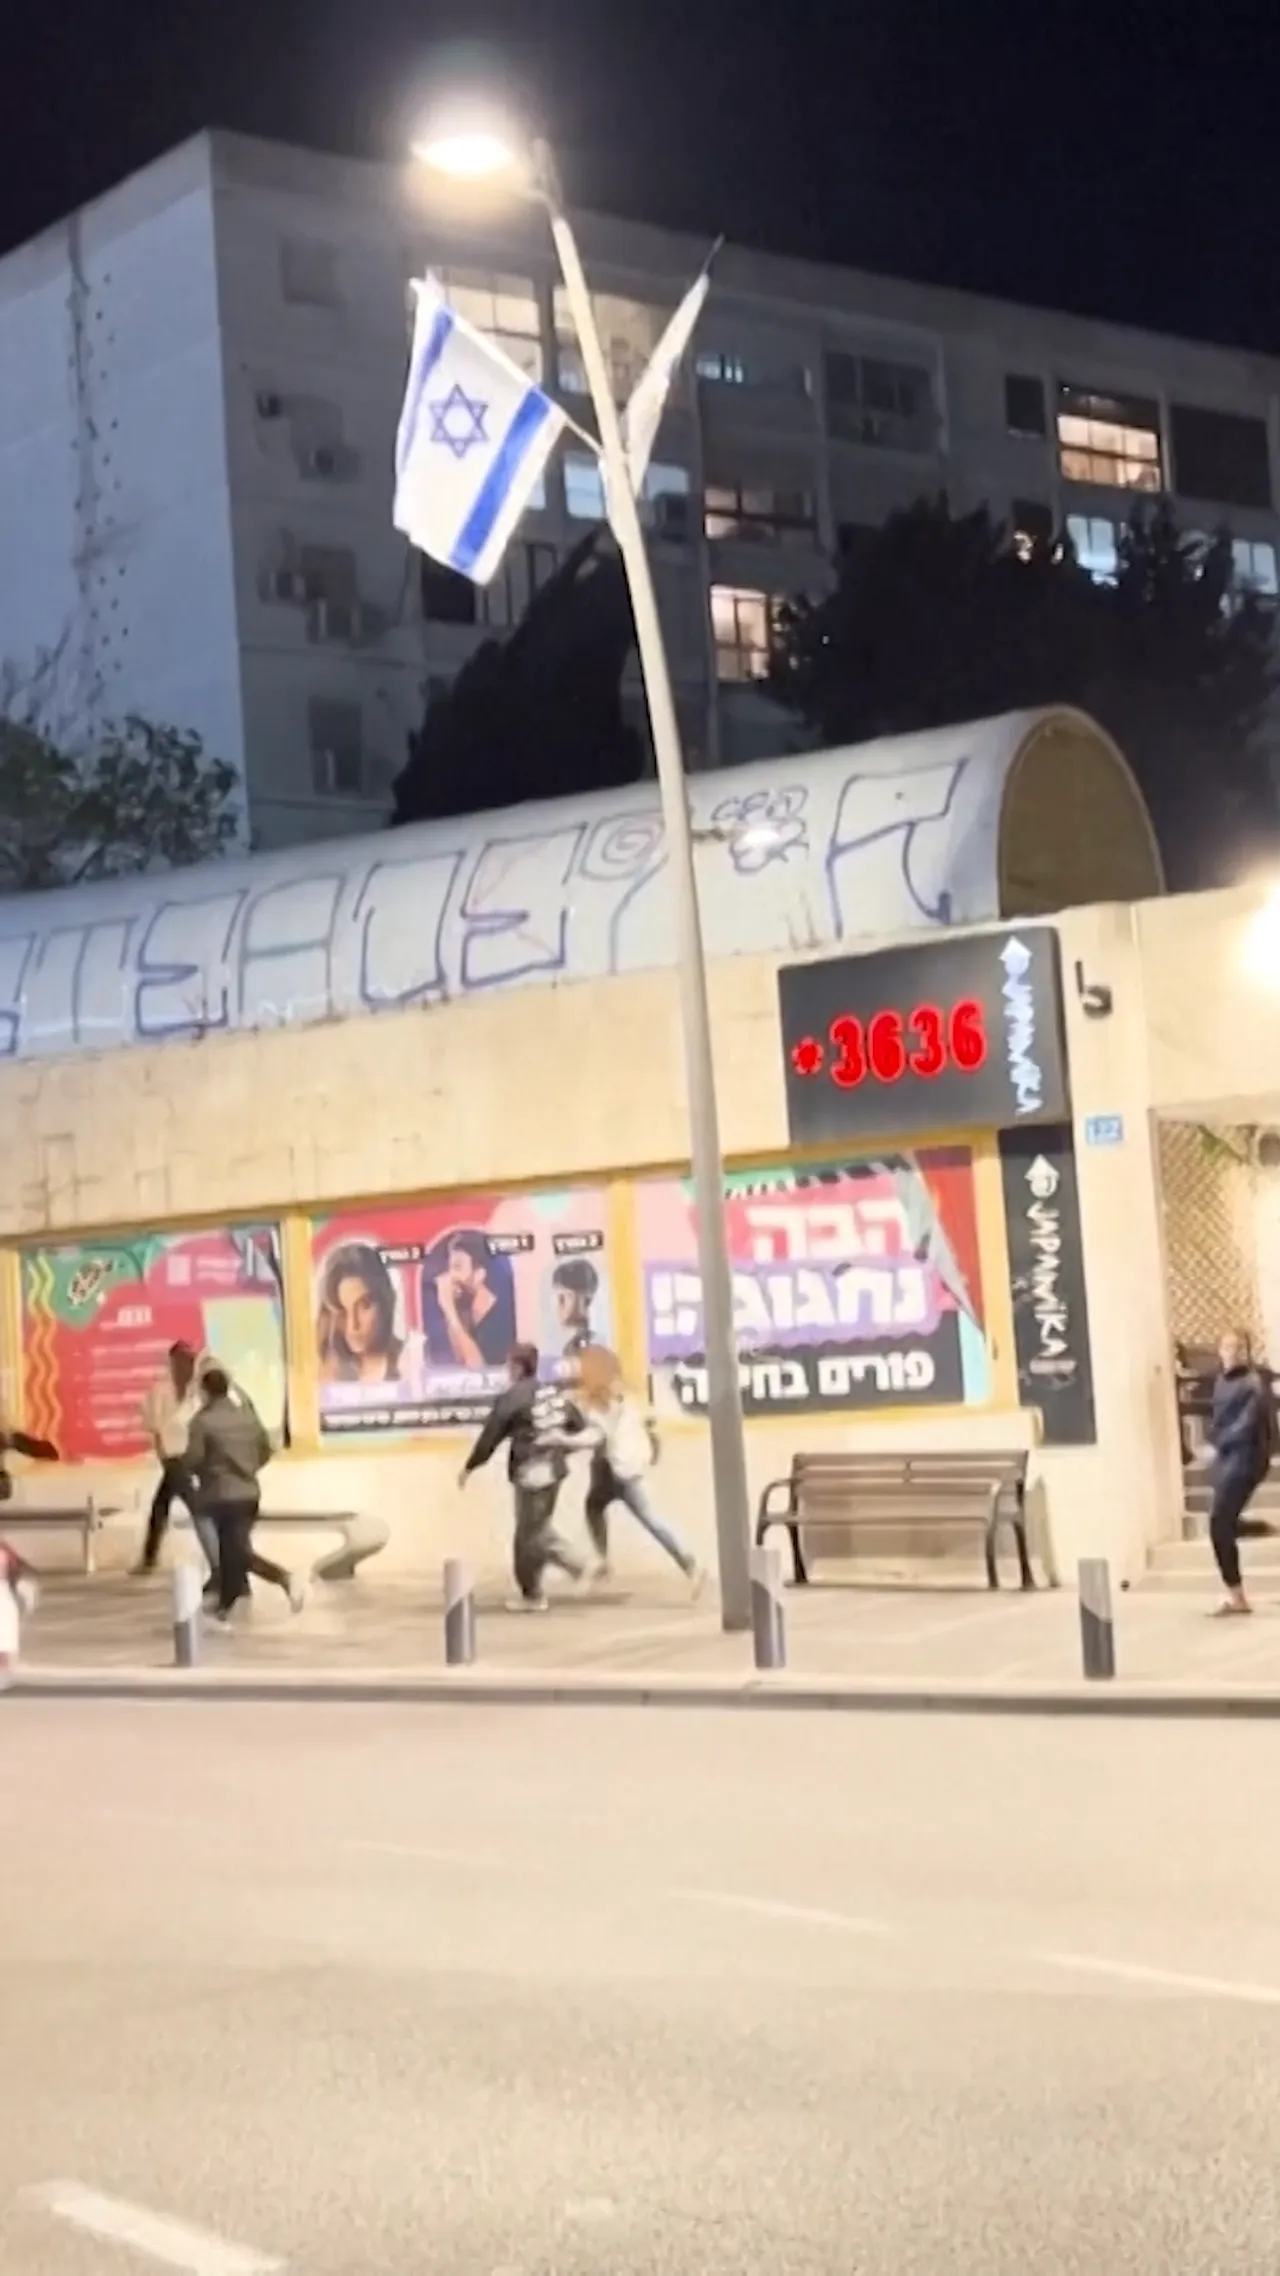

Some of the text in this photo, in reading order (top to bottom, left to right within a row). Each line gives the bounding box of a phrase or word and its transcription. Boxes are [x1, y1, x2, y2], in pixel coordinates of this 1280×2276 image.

[745, 1198, 914, 1264] הבה
[673, 1351, 935, 1404] פורים בחיה
